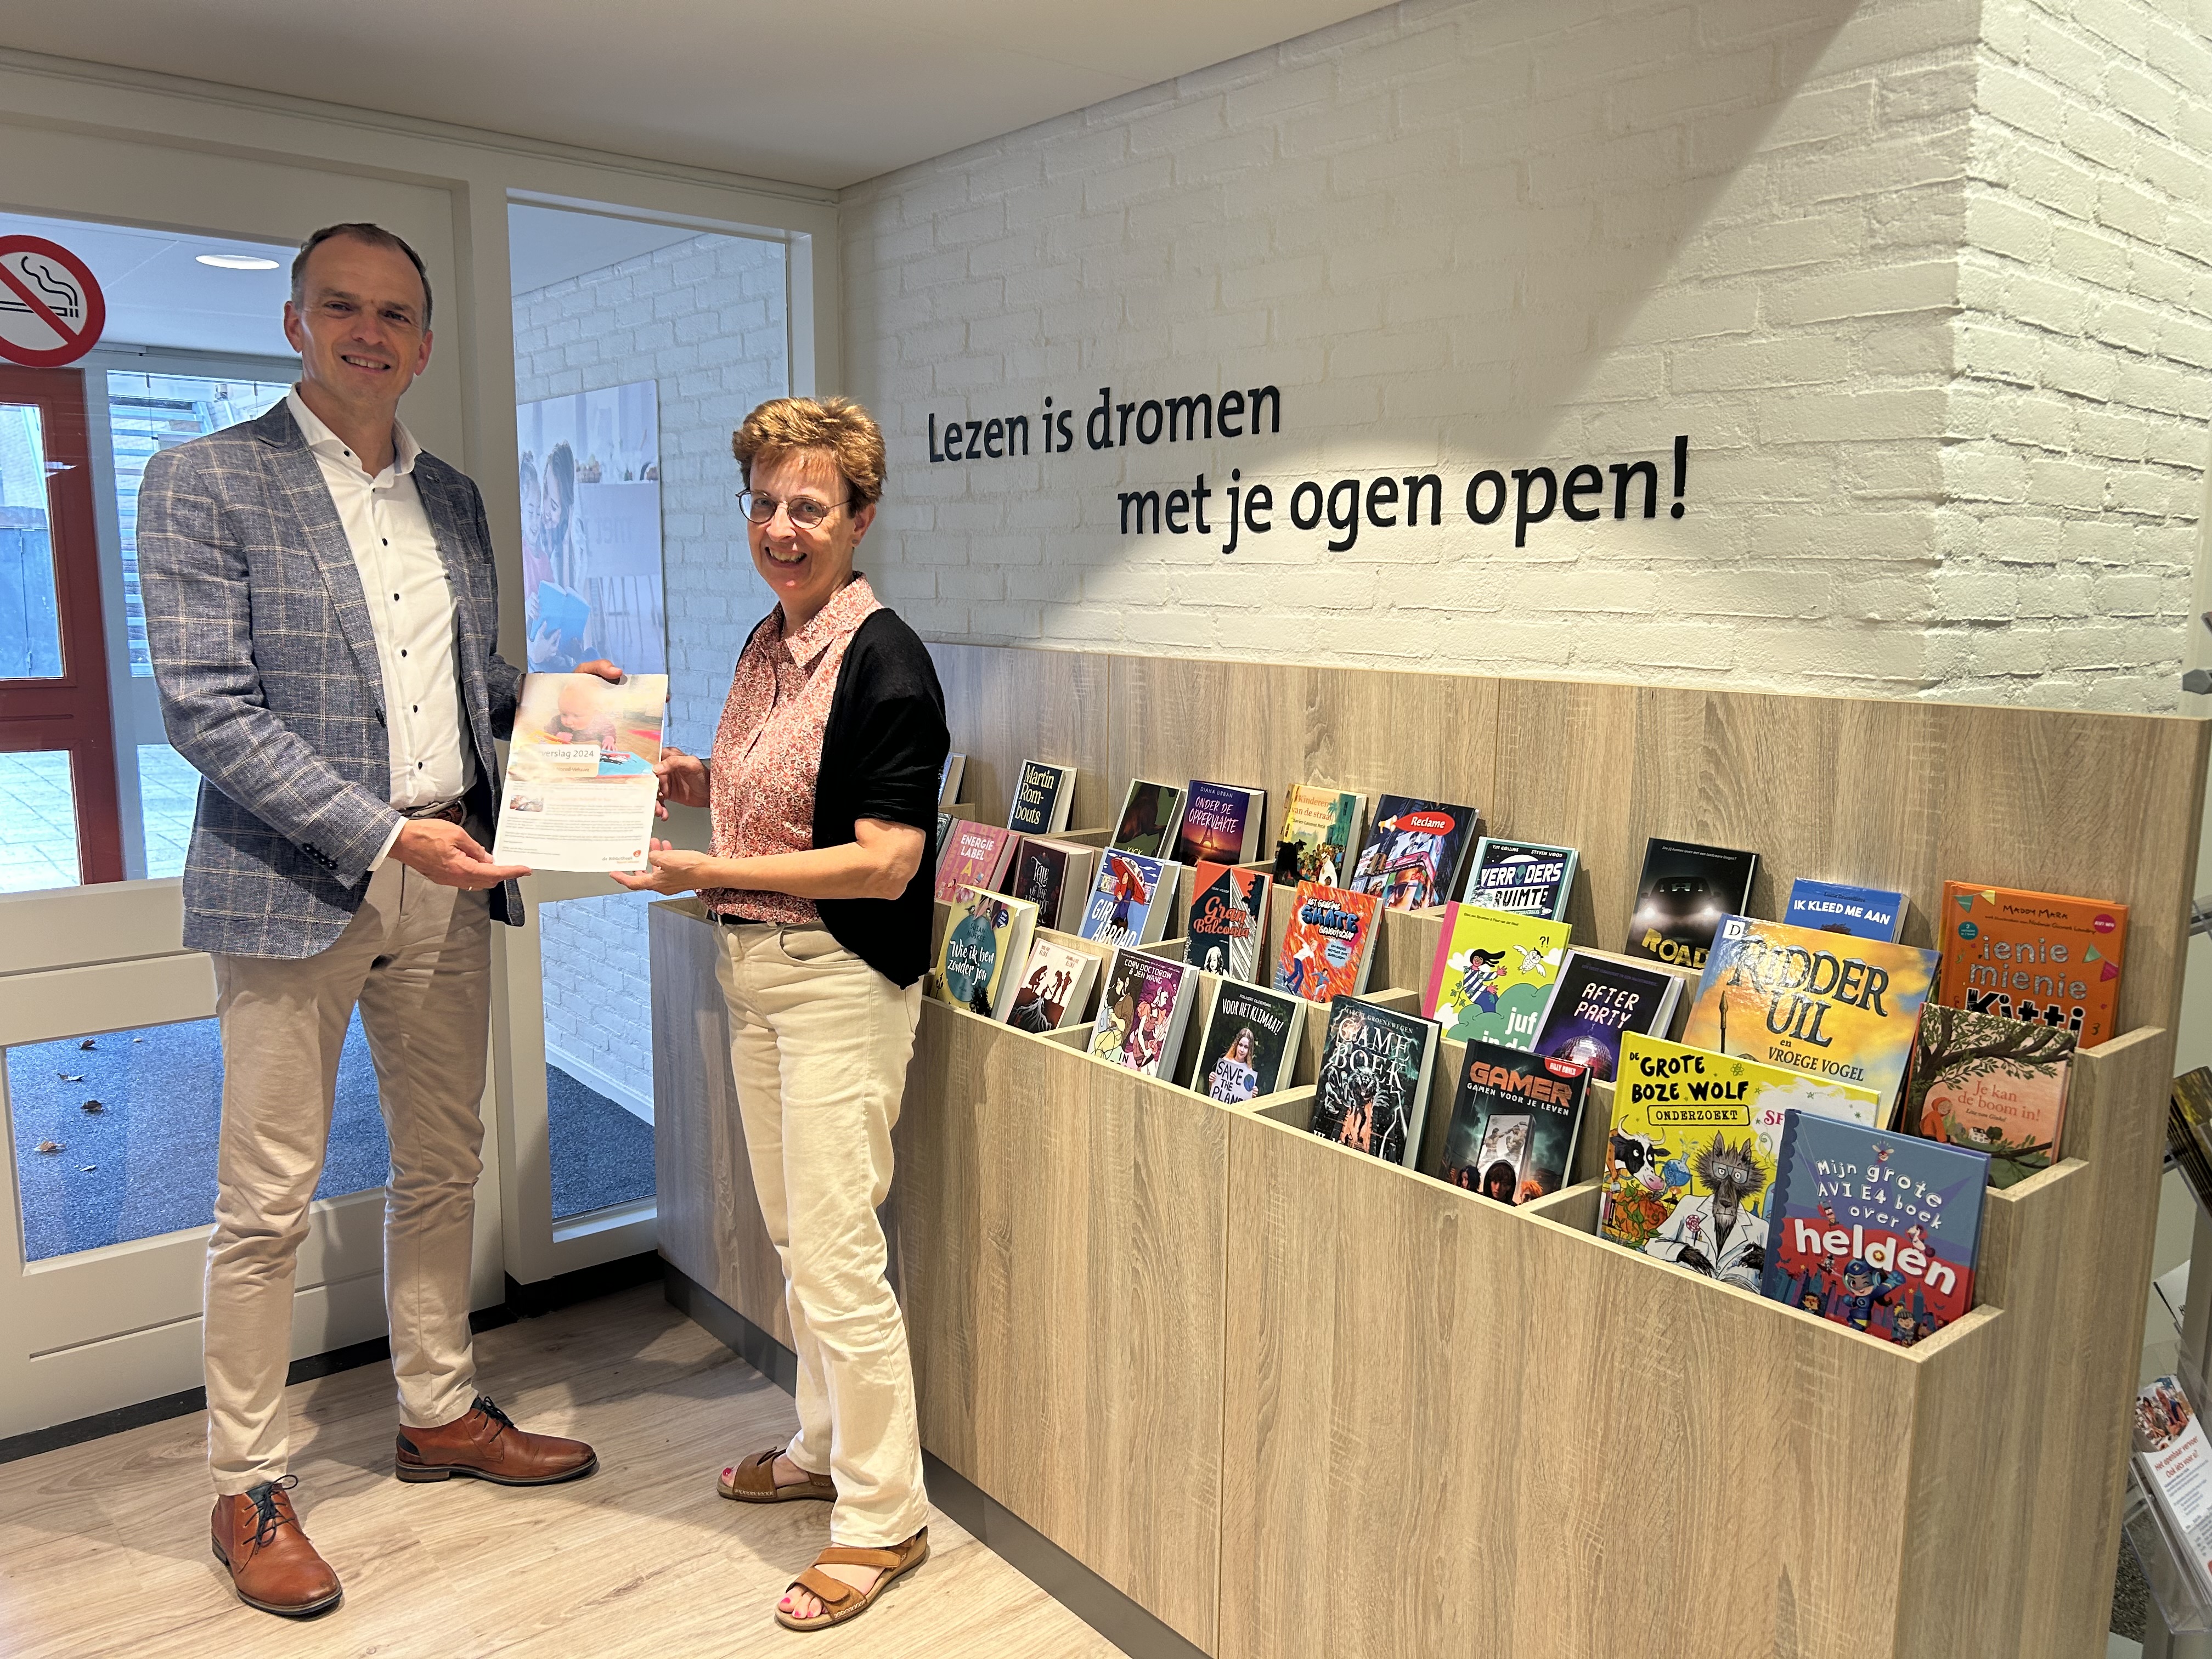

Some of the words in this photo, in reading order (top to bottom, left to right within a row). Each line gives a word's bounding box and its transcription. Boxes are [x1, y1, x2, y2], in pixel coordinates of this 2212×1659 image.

[929, 413, 1029, 462] Lezen
[1042, 397, 1074, 453] is
[1087, 385, 1280, 450] dromen
[1118, 474, 1211, 535] met
[1222, 469, 1273, 554] je
[1290, 472, 1442, 551] ogen
[1466, 435, 1689, 548] open!
[540, 749, 571, 759] verslag
[1024, 765, 1055, 790] Martin
[1019, 782, 1044, 805] Rom-
[1200, 786, 1215, 795] DIANA
[1217, 788, 1234, 799] URBAN
[1298, 795, 1329, 808] Kinderen
[1015, 800, 1041, 825] bouts
[1195, 796, 1220, 813] ONDER
[1221, 802, 1234, 815] DE
[1304, 808, 1312, 817] de
[1313, 811, 1332, 821] straat
[1188, 809, 1239, 833] OPPERVLAKTE
[1410, 816, 1446, 828] Reclame
[960, 846, 984, 860] LABEL
[961, 834, 995, 851] ENERGIE
[961, 859, 973, 877] A
[1031, 856, 1049, 887] TALE
[1036, 881, 1047, 900] THE
[1092, 899, 1118, 924] GIRL
[1204, 896, 1246, 924] Gran
[1301, 904, 1358, 932] SKATE
[1793, 900, 1807, 910] IK
[1808, 901, 1843, 913] KLEED
[1844, 905, 1864, 918] ME
[1864, 910, 1891, 925] AAN
[2003, 905, 2035, 915] MADDY
[967, 930, 986, 943] MUSKEE
[970, 923, 986, 933] SUSAN
[1091, 922, 1137, 947] ABROAD
[1193, 918, 1249, 939] Balconia
[1729, 922, 1741, 935] D
[950, 938, 967, 958] Wie
[969, 945, 978, 964] ik
[979, 946, 995, 964] ben
[1641, 928, 1709, 968] ROAD
[1982, 936, 2069, 964] ienie
[947, 958, 974, 977] zonder
[972, 963, 987, 985] jou
[1124, 958, 1139, 969] CORY
[1140, 964, 1172, 979] DOCTOROW
[1134, 970, 1146, 979] JEN
[1146, 973, 1163, 984] WANG
[1968, 963, 2088, 1000] mienie
[1582, 983, 1640, 1011] AFTER
[1222, 998, 1239, 1015] VOOR
[1239, 1002, 1251, 1018] HET
[1250, 1006, 1284, 1036] KLIMAAT!
[1344, 1007, 1366, 1020] MARCEL
[1367, 1015, 1414, 1034] GROENEWEGEN
[1505, 1006, 1538, 1035] juf
[1573, 1001, 1632, 1029] PARTY
[1766, 990, 1833, 1048] UIL
[1338, 1018, 1412, 1061] GAME
[1504, 1038, 1528, 1051] d
[1119, 1052, 1129, 1064] IN
[1333, 1041, 1407, 1091] BOEK
[1629, 1052, 1639, 1061] DE
[1640, 1054, 1705, 1079] GROTE
[1769, 1047, 1819, 1070] VROEGE
[1821, 1059, 1864, 1081] VOGEL
[1216, 1061, 1243, 1086] SAVE
[1221, 1079, 1233, 1092] THE
[1469, 1060, 1573, 1108] GAMER
[1211, 1086, 1243, 1105] PLAN
[1466, 1082, 1496, 1096] GAMEN
[1500, 1091, 1523, 1104] VOOR
[1541, 1103, 1570, 1116] LEVEN
[1632, 1082, 1680, 1103] BOZE
[1686, 1081, 1750, 1102] WOLF
[1972, 1080, 1988, 1096] Je
[1991, 1084, 2017, 1102] kan
[1656, 1109, 1738, 1120] ONDERZOEKT
[1957, 1091, 1974, 1105] de
[1978, 1096, 2017, 1116] boom
[2022, 1106, 2040, 1121] in!
[1816, 1159, 1858, 1178] Mijn
[1865, 1164, 1943, 1209] grote
[1816, 1181, 1852, 1198] AVI
[1861, 1184, 1887, 1205] E4
[1895, 1194, 1943, 1230] boek
[1848, 1205, 1901, 1228] over
[1793, 1218, 1957, 1296] helden
